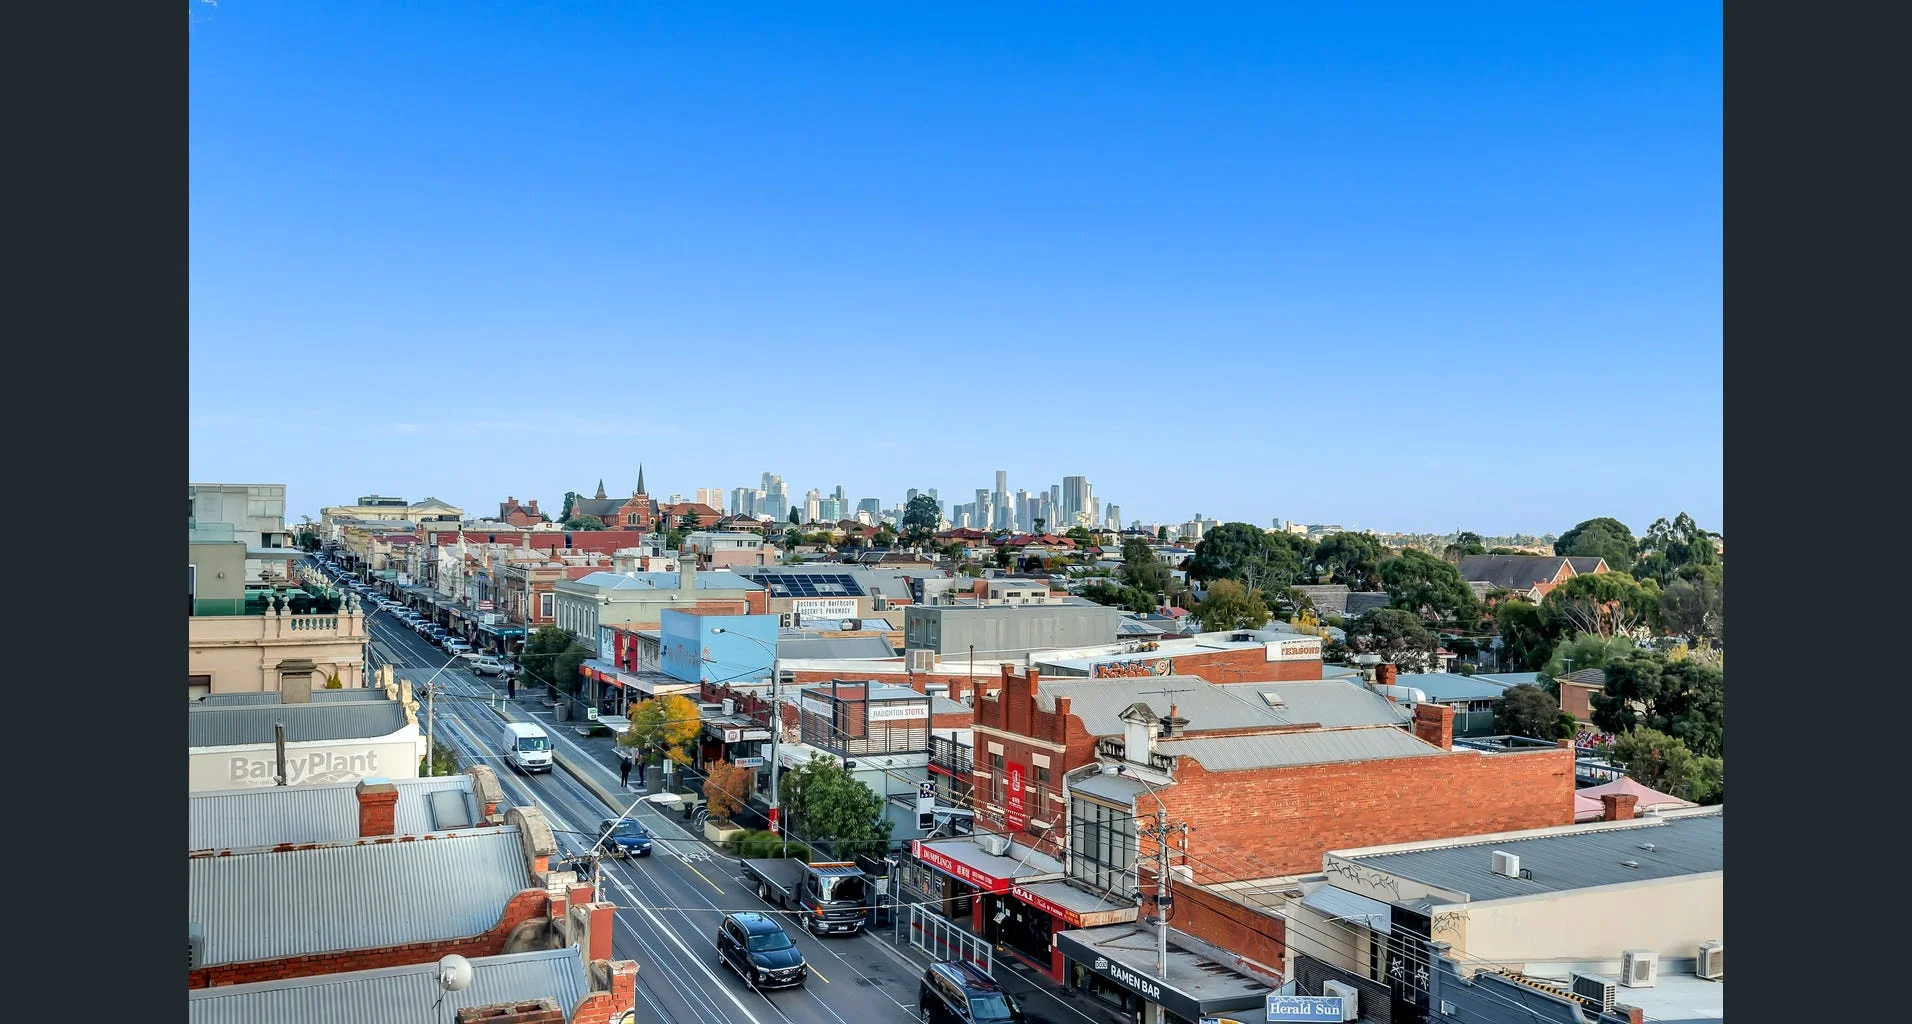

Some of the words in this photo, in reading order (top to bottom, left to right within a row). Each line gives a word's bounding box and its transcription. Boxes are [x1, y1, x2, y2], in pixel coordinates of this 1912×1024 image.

[873, 708, 904, 718] HAUGHTON
[923, 848, 953, 870] DUMPLINGS
[1110, 964, 1140, 990] RAMEN
[1141, 980, 1161, 1000] BAR
[1270, 1003, 1311, 1015] Herald
[1315, 1003, 1340, 1015] Sun
